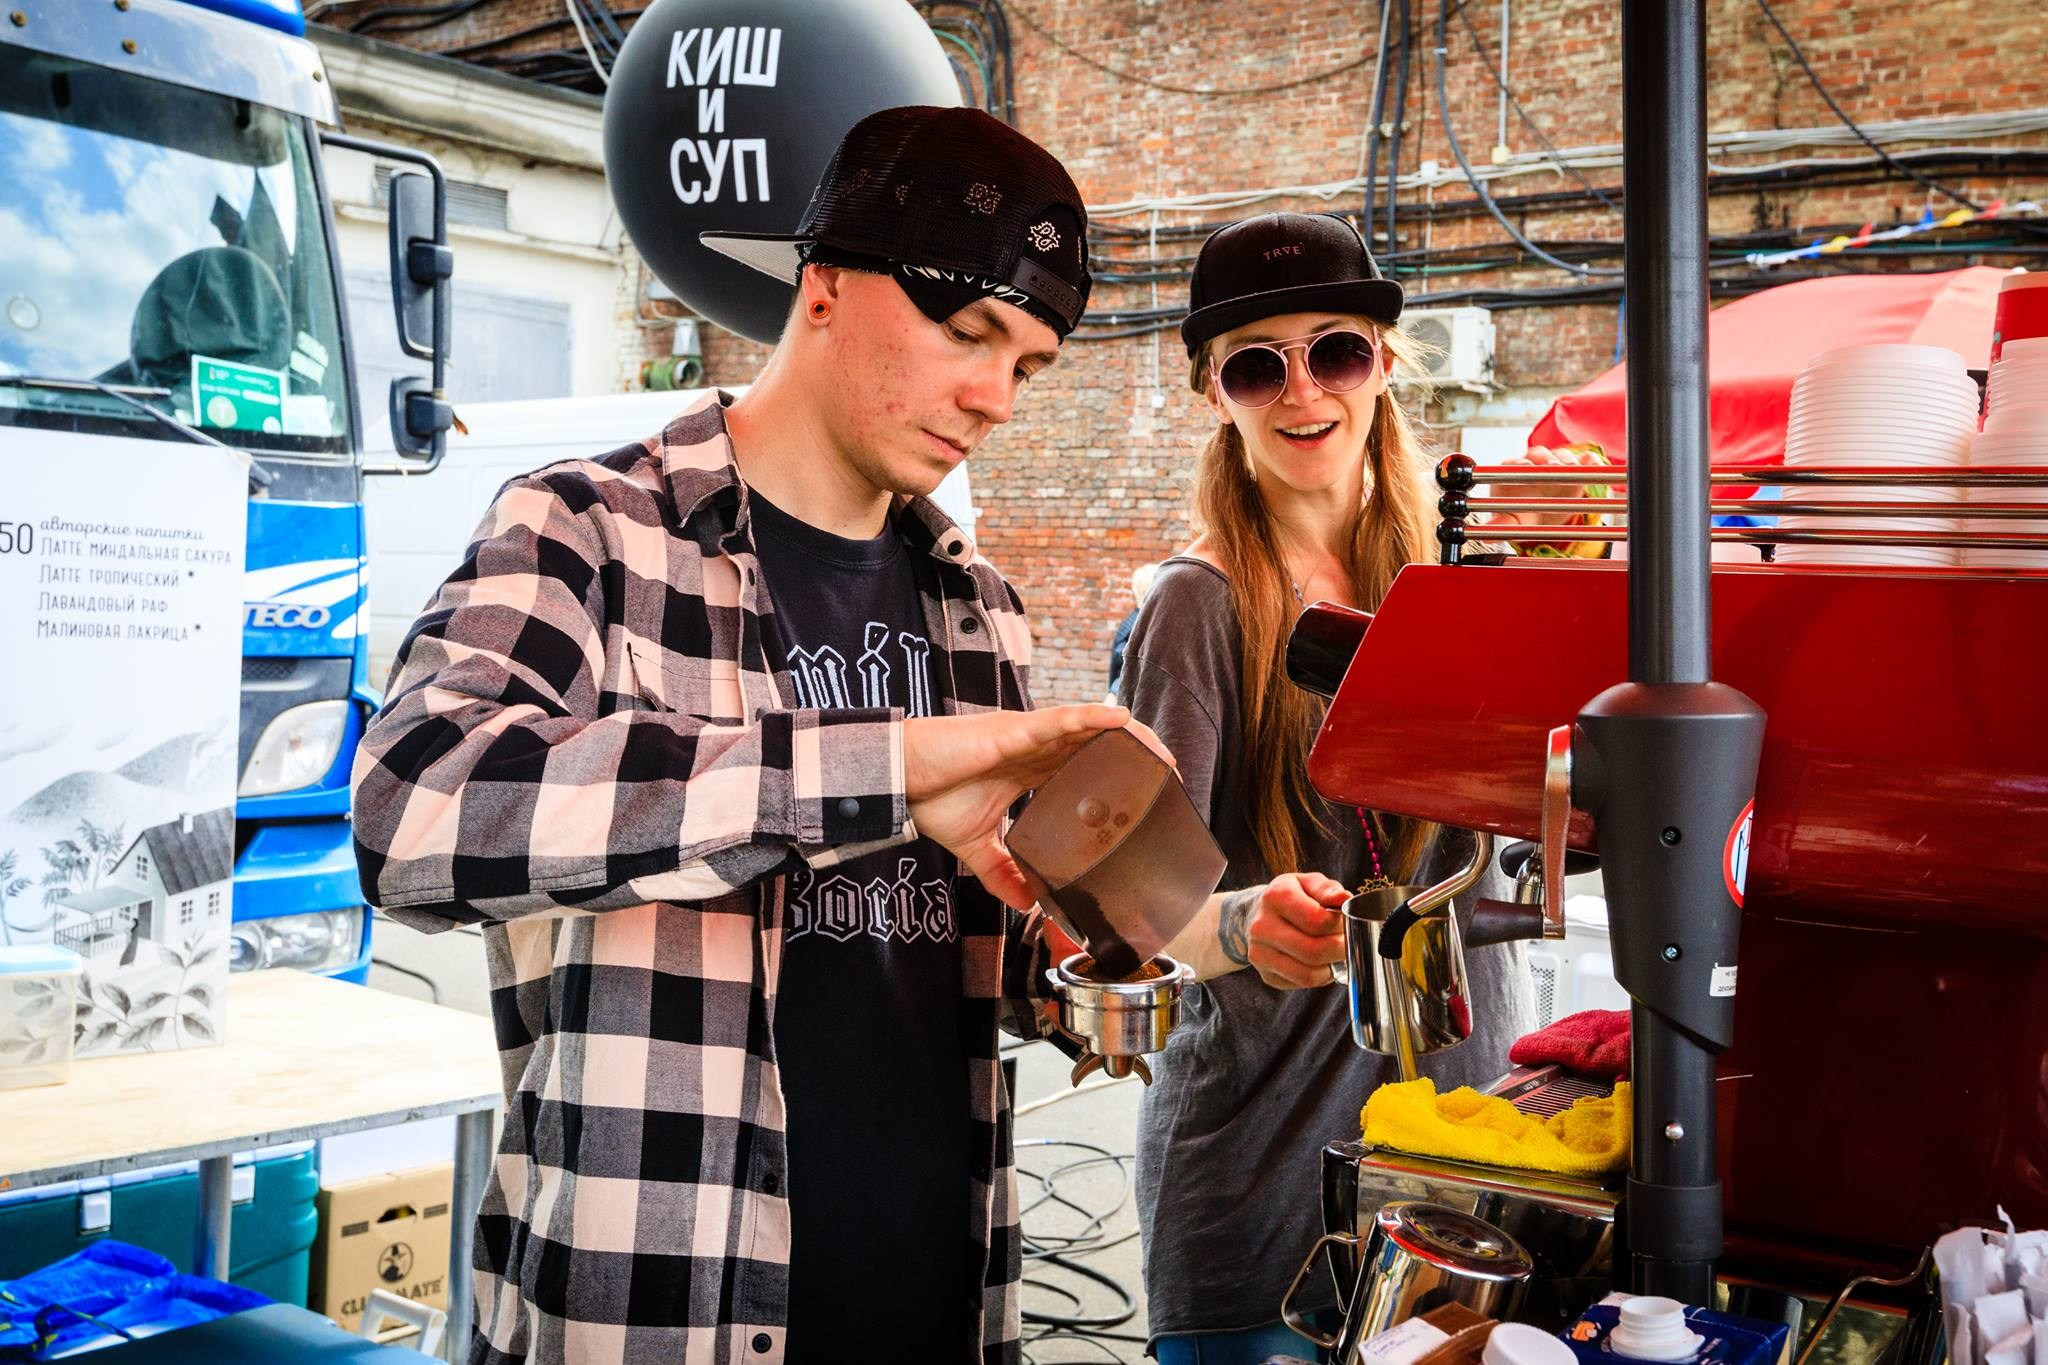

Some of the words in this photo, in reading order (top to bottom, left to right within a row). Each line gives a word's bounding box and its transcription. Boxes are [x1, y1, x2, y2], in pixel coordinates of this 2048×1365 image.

[666, 26, 782, 88] КИШ
[698, 87, 725, 133] И
[669, 137, 770, 204] СУП
[40, 516, 131, 540] авторские
[135, 527, 205, 541] напитки
